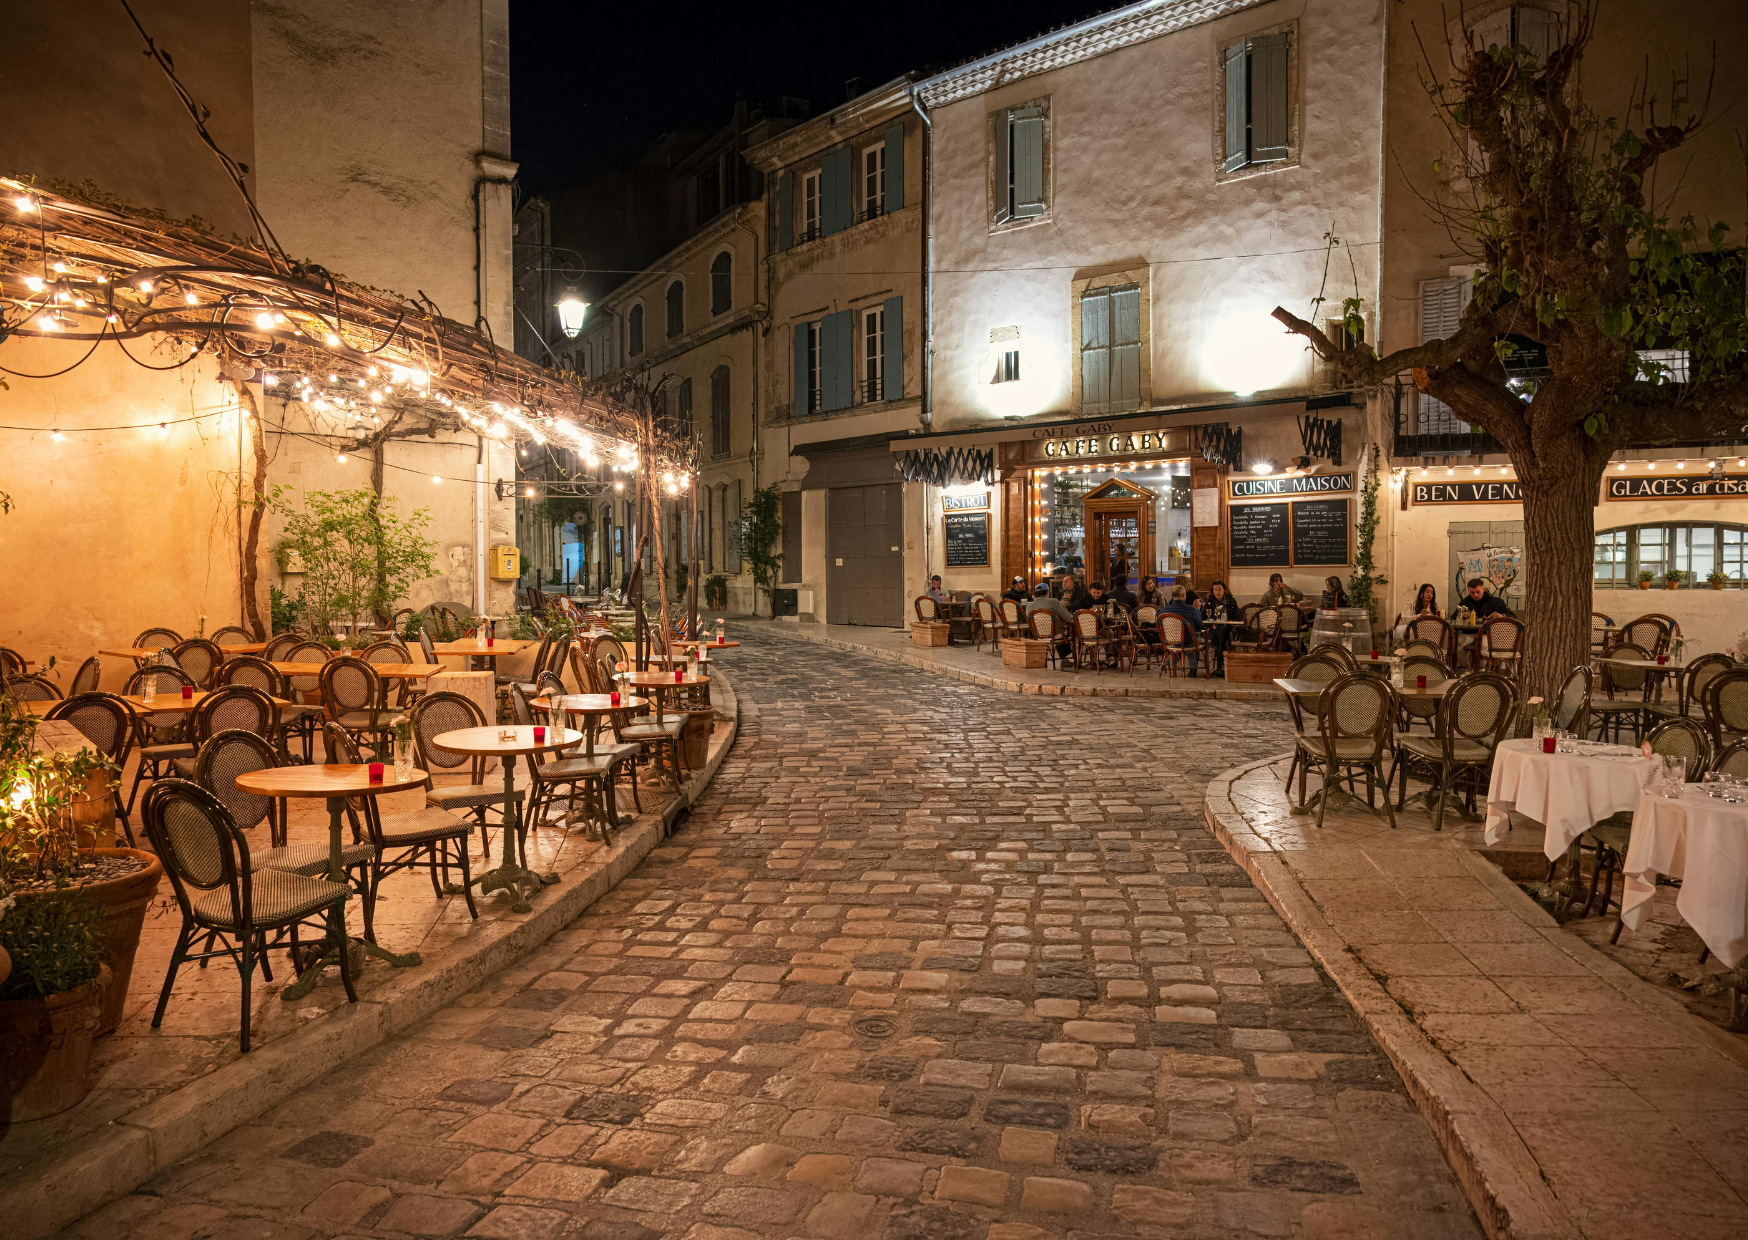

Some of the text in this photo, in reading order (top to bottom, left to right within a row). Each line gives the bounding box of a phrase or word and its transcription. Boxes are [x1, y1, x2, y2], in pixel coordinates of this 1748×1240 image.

[1032, 422, 1115, 439] CAFE GABY
[1044, 432, 1167, 457] CAFE GABY
[1234, 475, 1351, 495] CUISINE MAISON
[1416, 483, 1522, 501] BEN VEN
[1612, 479, 1689, 496] GLACES
[945, 494, 987, 509] BISTROT
